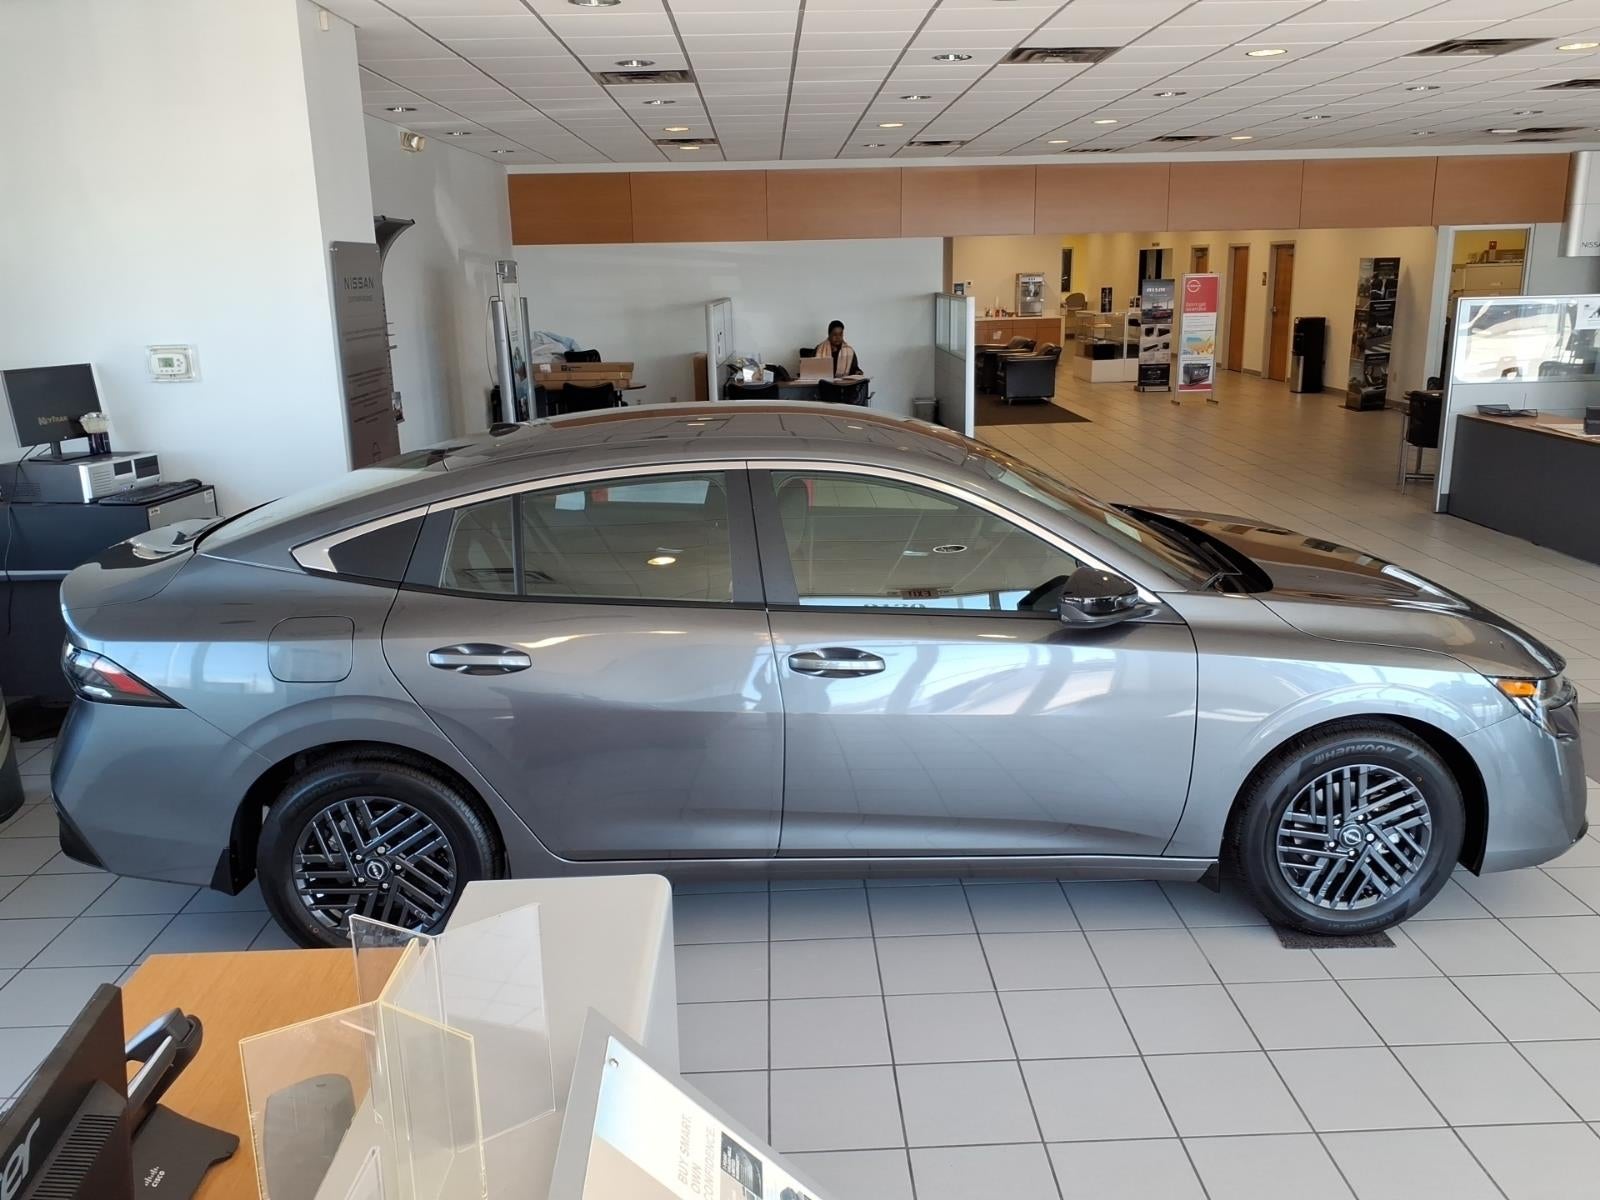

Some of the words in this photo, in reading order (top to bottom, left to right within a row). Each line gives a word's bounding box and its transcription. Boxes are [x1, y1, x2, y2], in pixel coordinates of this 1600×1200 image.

[343, 277, 375, 290] NISSAN
[151, 1170, 165, 1187] CISCO
[677, 1156, 689, 1185] BUY
[690, 1162, 702, 1194] OWN
